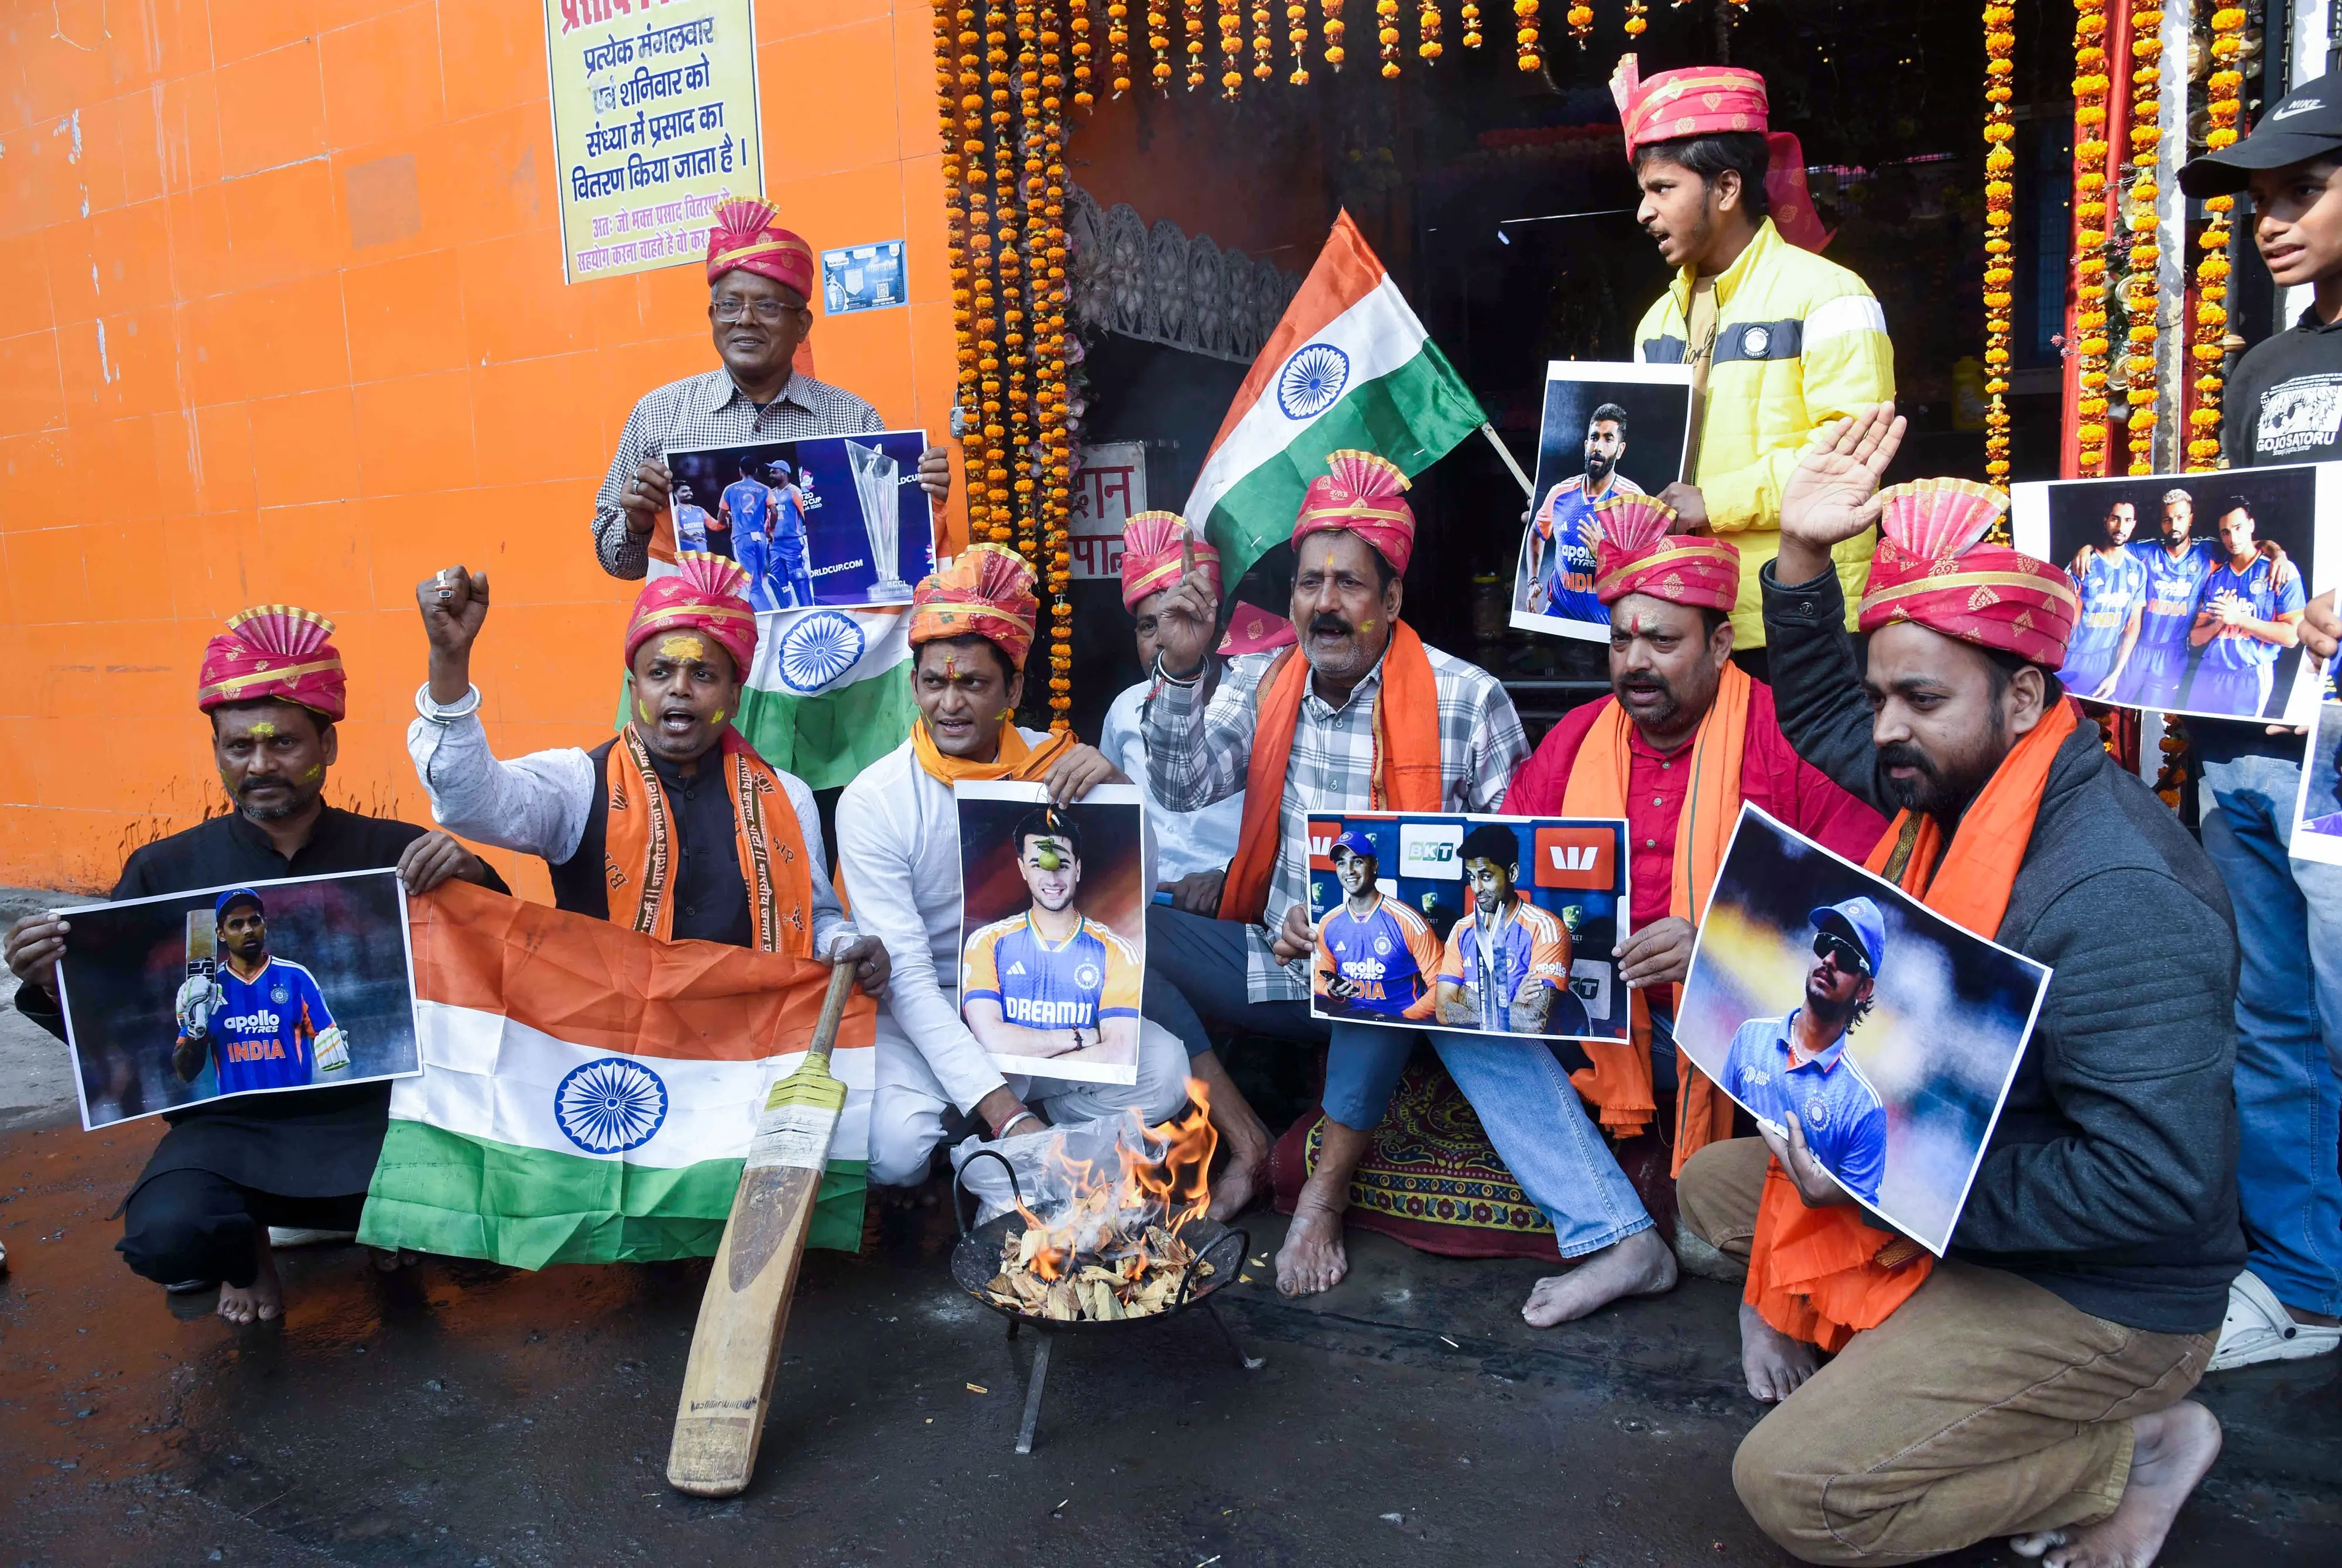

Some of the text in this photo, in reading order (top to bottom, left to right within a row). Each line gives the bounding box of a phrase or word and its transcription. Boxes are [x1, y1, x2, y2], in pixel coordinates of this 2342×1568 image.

[583, 33, 634, 79] प्रत्येक
[637, 16, 714, 59] मंगलवार
[620, 66, 683, 107] शनिवार
[684, 52, 710, 90] को
[2288, 99, 2320, 109] NIKE
[586, 102, 724, 158] संध्या में प्रसाद का
[571, 165, 625, 201] वितरण
[628, 153, 670, 190] किया
[672, 147, 716, 179] जाता
[719, 132, 733, 173] है
[615, 208, 629, 232] जो
[655, 201, 682, 227] प्रसाद
[577, 245, 610, 272] सहयोग
[611, 242, 638, 265] करना
[639, 232, 665, 259] चाहते
[742, 493, 755, 514] 2
[808, 497, 821, 505] CUP
[1562, 545, 1593, 562] apol
[1562, 570, 1597, 594] INDI
[2148, 598, 2187, 617] INDIA
[1409, 841, 1454, 861] BKT
[651, 843, 666, 886] भारतीय
[1342, 957, 1386, 976] apollo
[1354, 972, 1384, 980] TYRES
[1536, 961, 1566, 974] apollo
[1348, 980, 1386, 1000] DIA
[224, 1010, 280, 1032] apollo
[1005, 997, 1092, 1025] DREAM11
[245, 1025, 279, 1034] TYRES
[227, 1039, 286, 1063] INDIA
